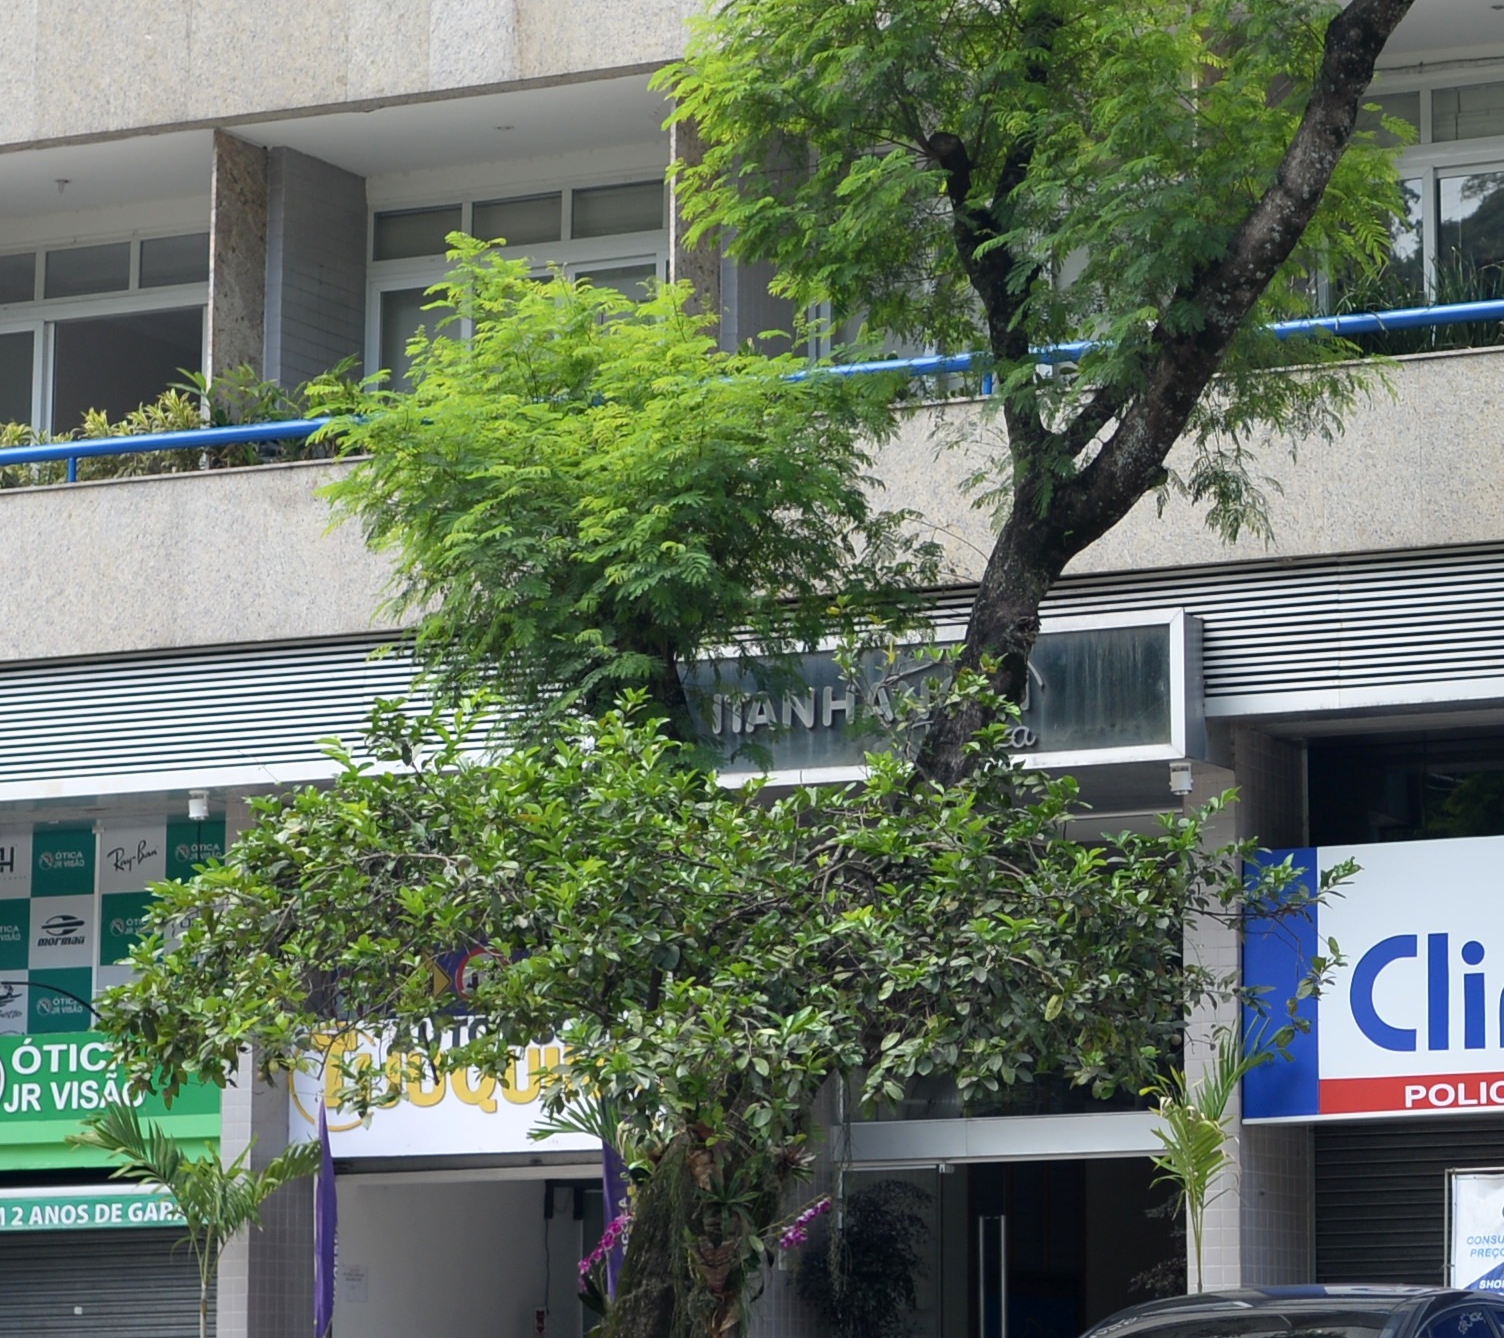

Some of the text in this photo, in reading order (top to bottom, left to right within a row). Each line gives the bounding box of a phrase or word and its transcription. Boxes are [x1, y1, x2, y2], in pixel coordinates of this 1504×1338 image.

[3, 1072, 146, 1114] JR VISÃO
[11, 1205, 23, 1227] 2
[28, 1203, 89, 1226] ANOS
[93, 1202, 124, 1224] DE
